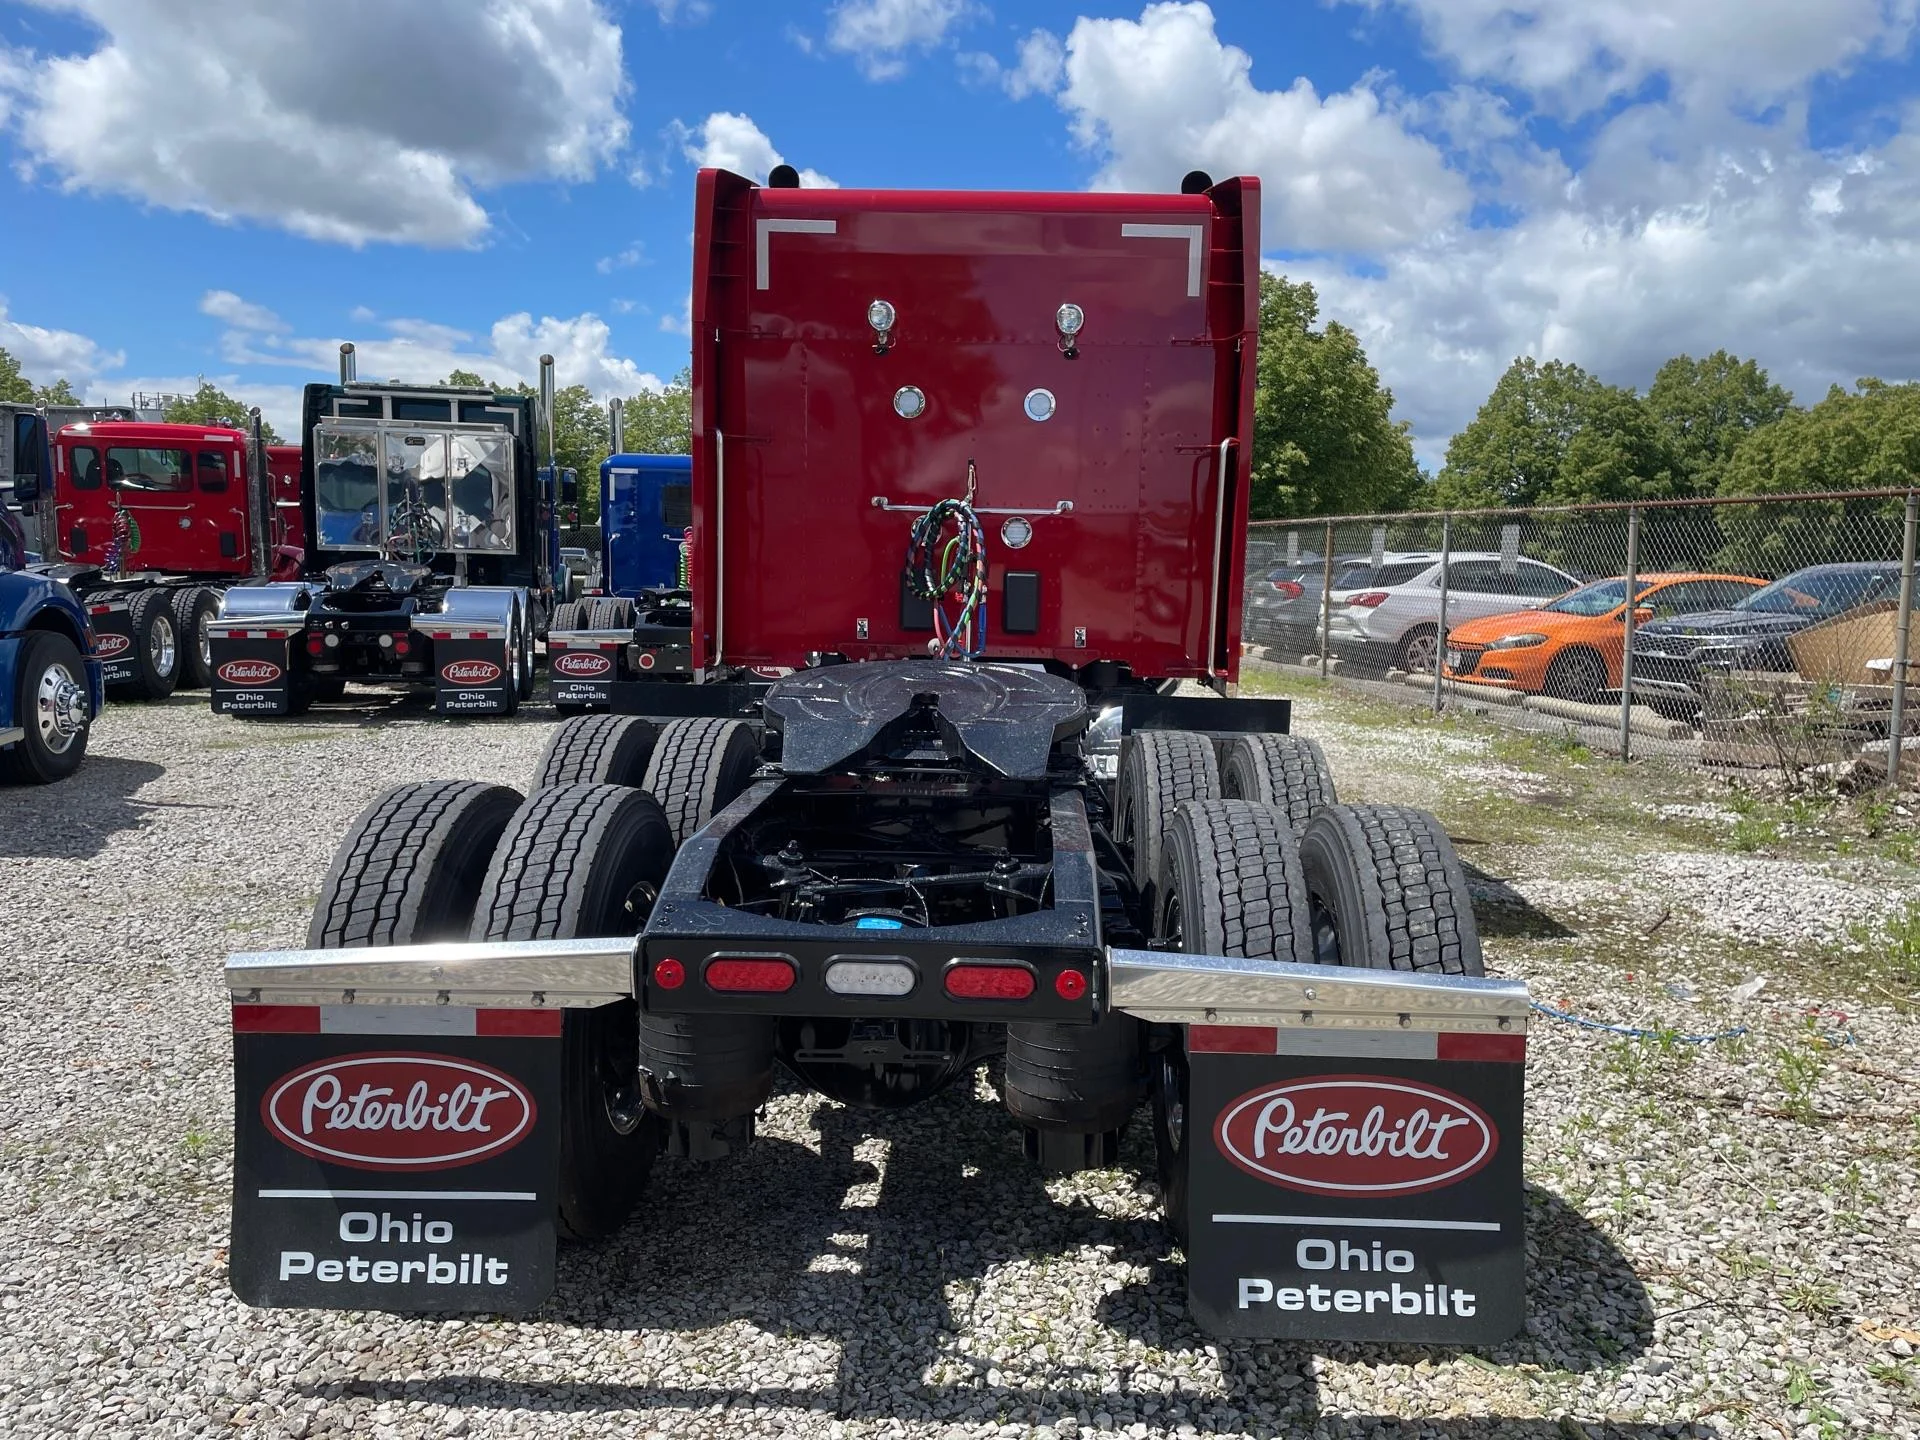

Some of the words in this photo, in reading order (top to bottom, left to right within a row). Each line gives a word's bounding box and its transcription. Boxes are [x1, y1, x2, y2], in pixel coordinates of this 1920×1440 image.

[561, 657, 606, 670] Peterbilt
[225, 665, 276, 678] Peterbilt
[449, 665, 496, 678] Peterbilt
[235, 693, 264, 701] Ohio
[458, 692, 485, 700] Ohio
[557, 691, 607, 699] Peterbilt
[222, 701, 277, 709] Peterbilt
[446, 700, 498, 708] Peterbilt
[302, 1074, 510, 1134] Peterbilt
[1254, 1097, 1470, 1159] Peterbilt
[339, 1211, 453, 1243] Ohio
[1296, 1238, 1415, 1273] Ohio
[279, 1251, 509, 1285] Peterbilt
[1238, 1278, 1476, 1317] Peterbilt
